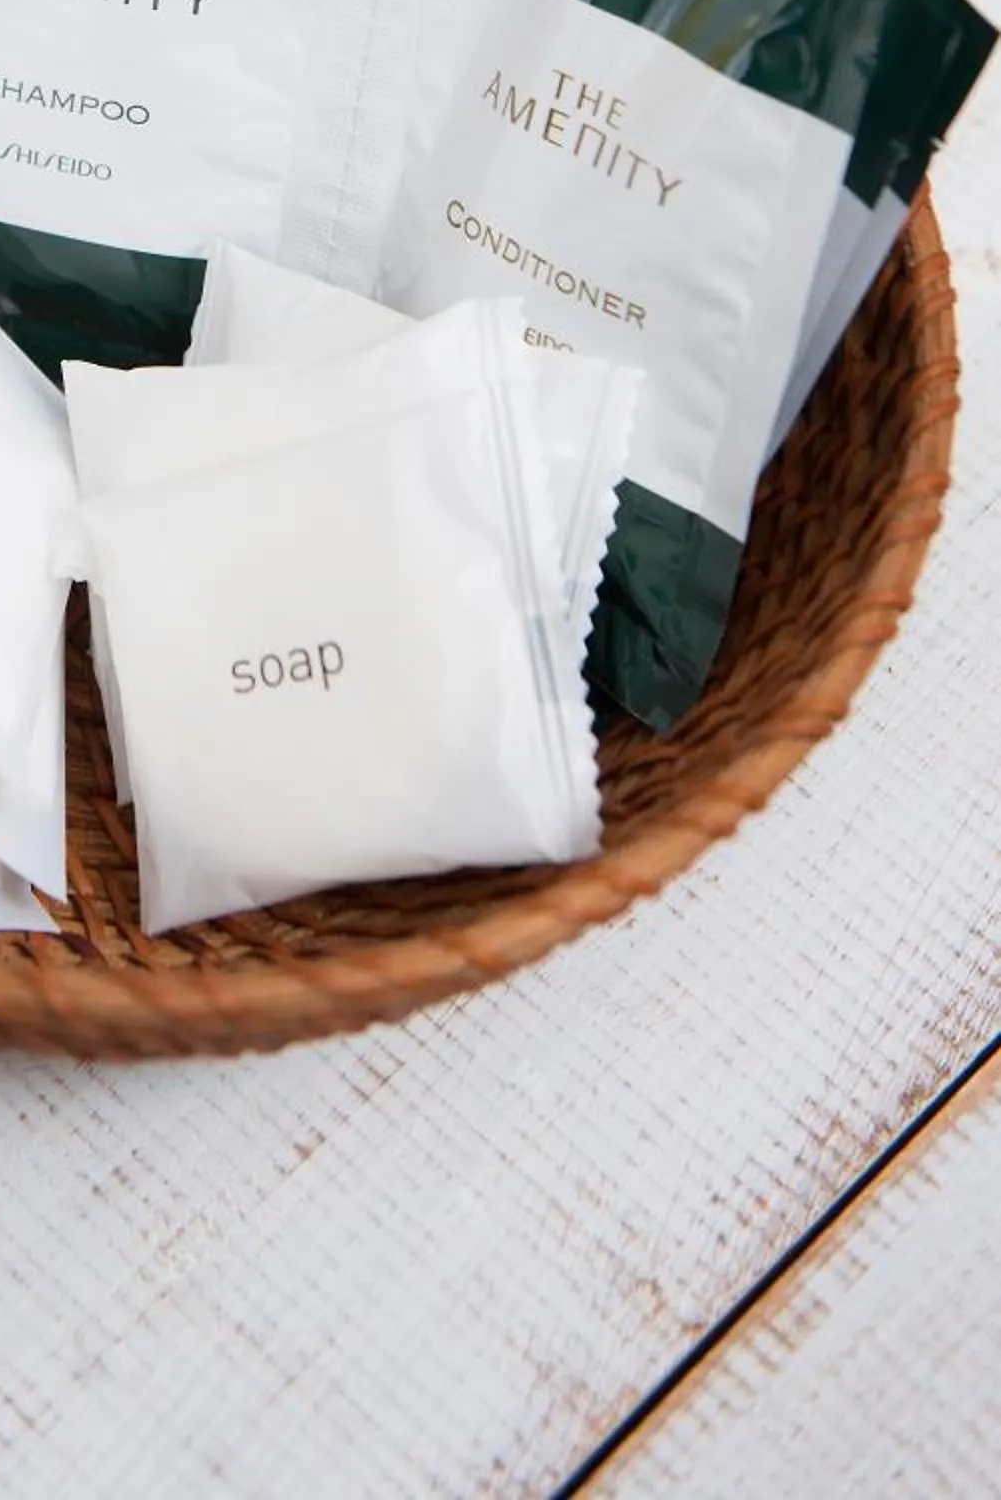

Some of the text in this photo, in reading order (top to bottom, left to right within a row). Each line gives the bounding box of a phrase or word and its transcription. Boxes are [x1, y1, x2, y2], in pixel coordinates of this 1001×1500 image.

[483, 69, 683, 208] AMENITY
[551, 68, 627, 131] THE
[446, 198, 648, 331] CONDITIONER
[231, 640, 344, 694] soap
